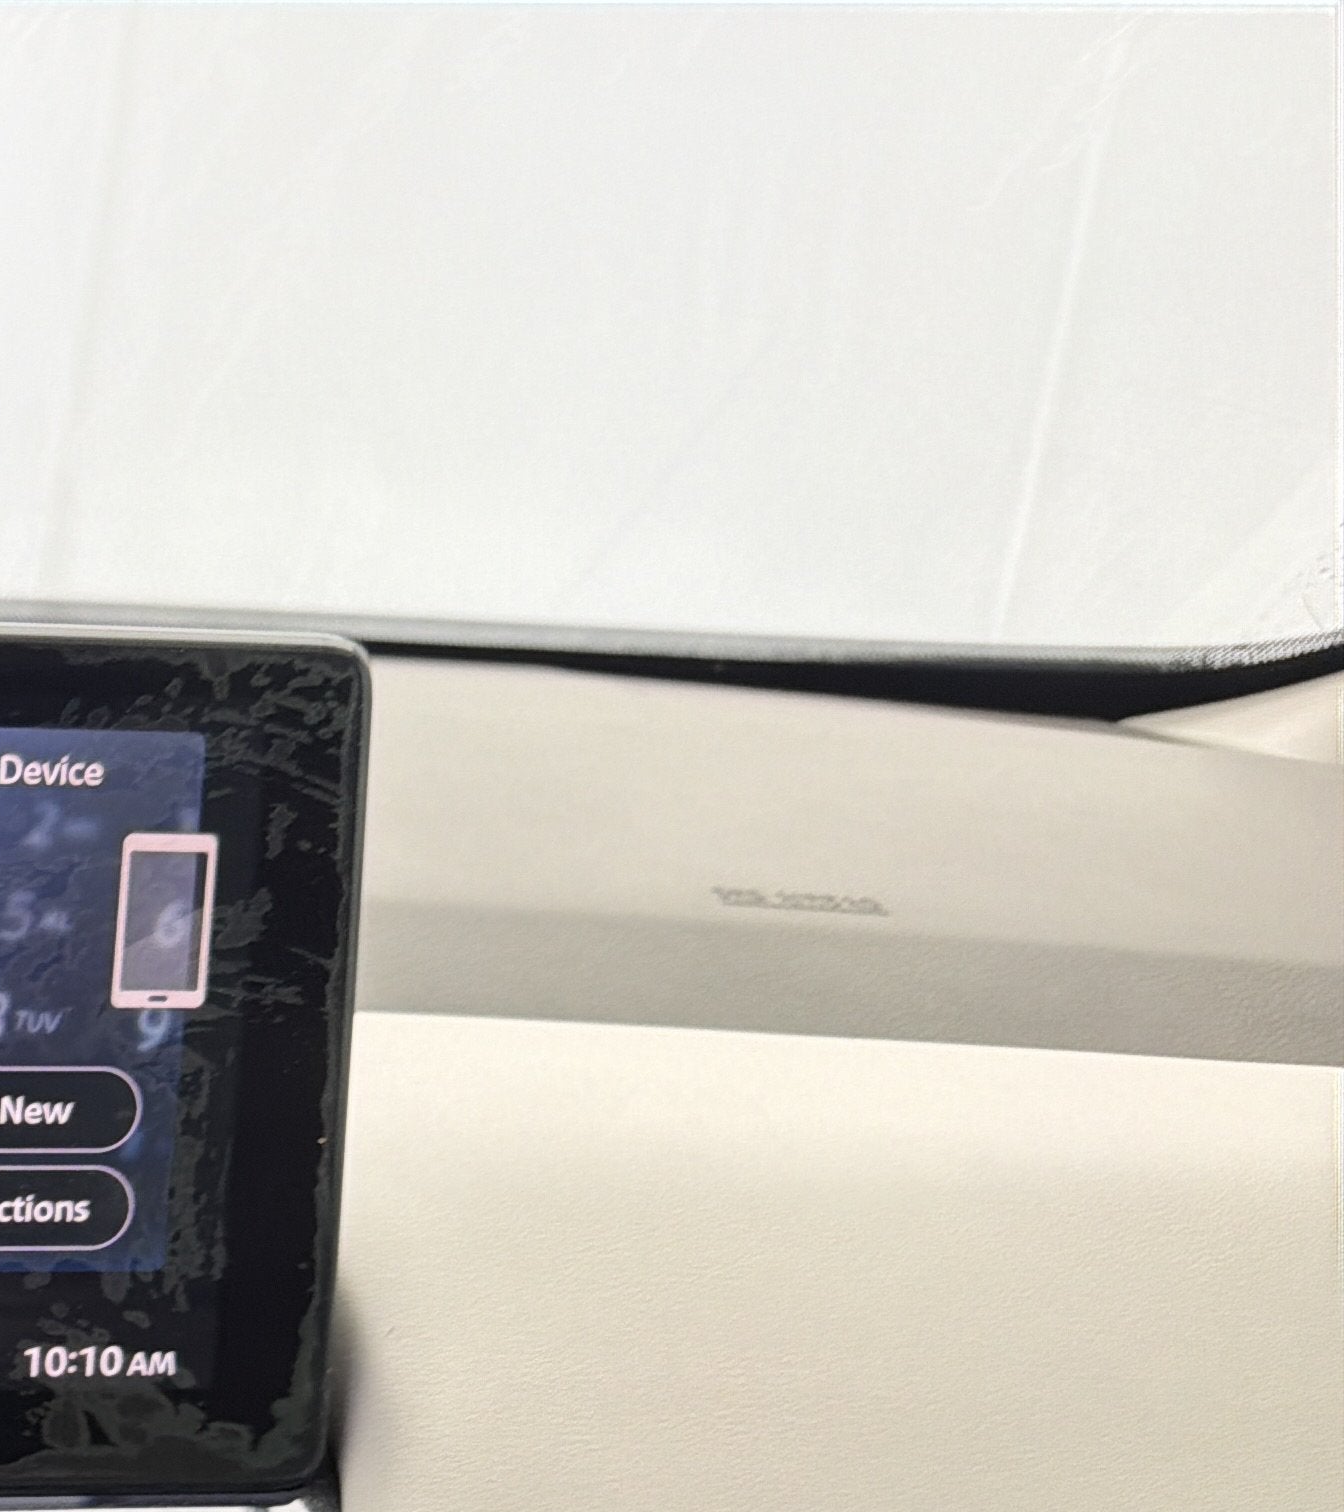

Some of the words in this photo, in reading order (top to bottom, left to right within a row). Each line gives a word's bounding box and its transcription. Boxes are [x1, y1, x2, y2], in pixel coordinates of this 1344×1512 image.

[14, 1008, 65, 1035] TUV
[137, 1009, 172, 1052] 9
[23, 1345, 124, 1377] 10:10
[127, 1350, 177, 1377] AM
